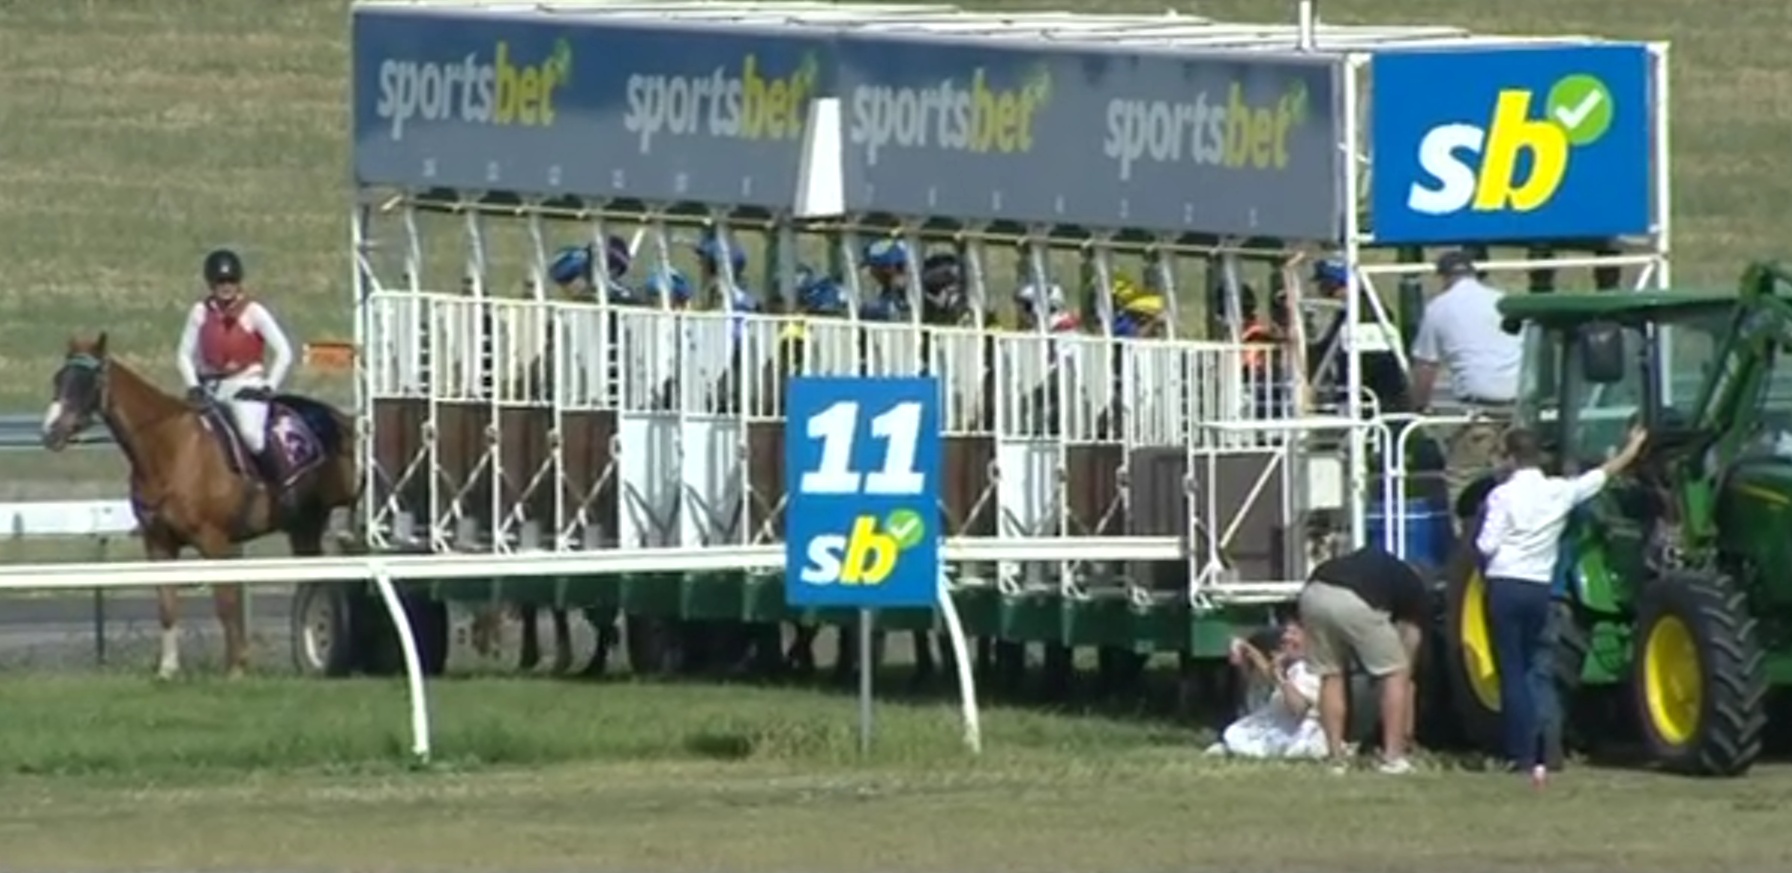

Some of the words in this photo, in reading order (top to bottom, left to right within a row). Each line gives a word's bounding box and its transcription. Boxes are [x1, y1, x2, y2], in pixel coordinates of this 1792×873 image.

[377, 40, 559, 140] sportsbet
[623, 54, 803, 154] sportsbet
[850, 67, 1036, 165] sportsbet
[1104, 81, 1292, 181] sportsbet
[1407, 87, 1568, 214] sb
[801, 401, 925, 494] 11
[800, 515, 898, 585] sb
